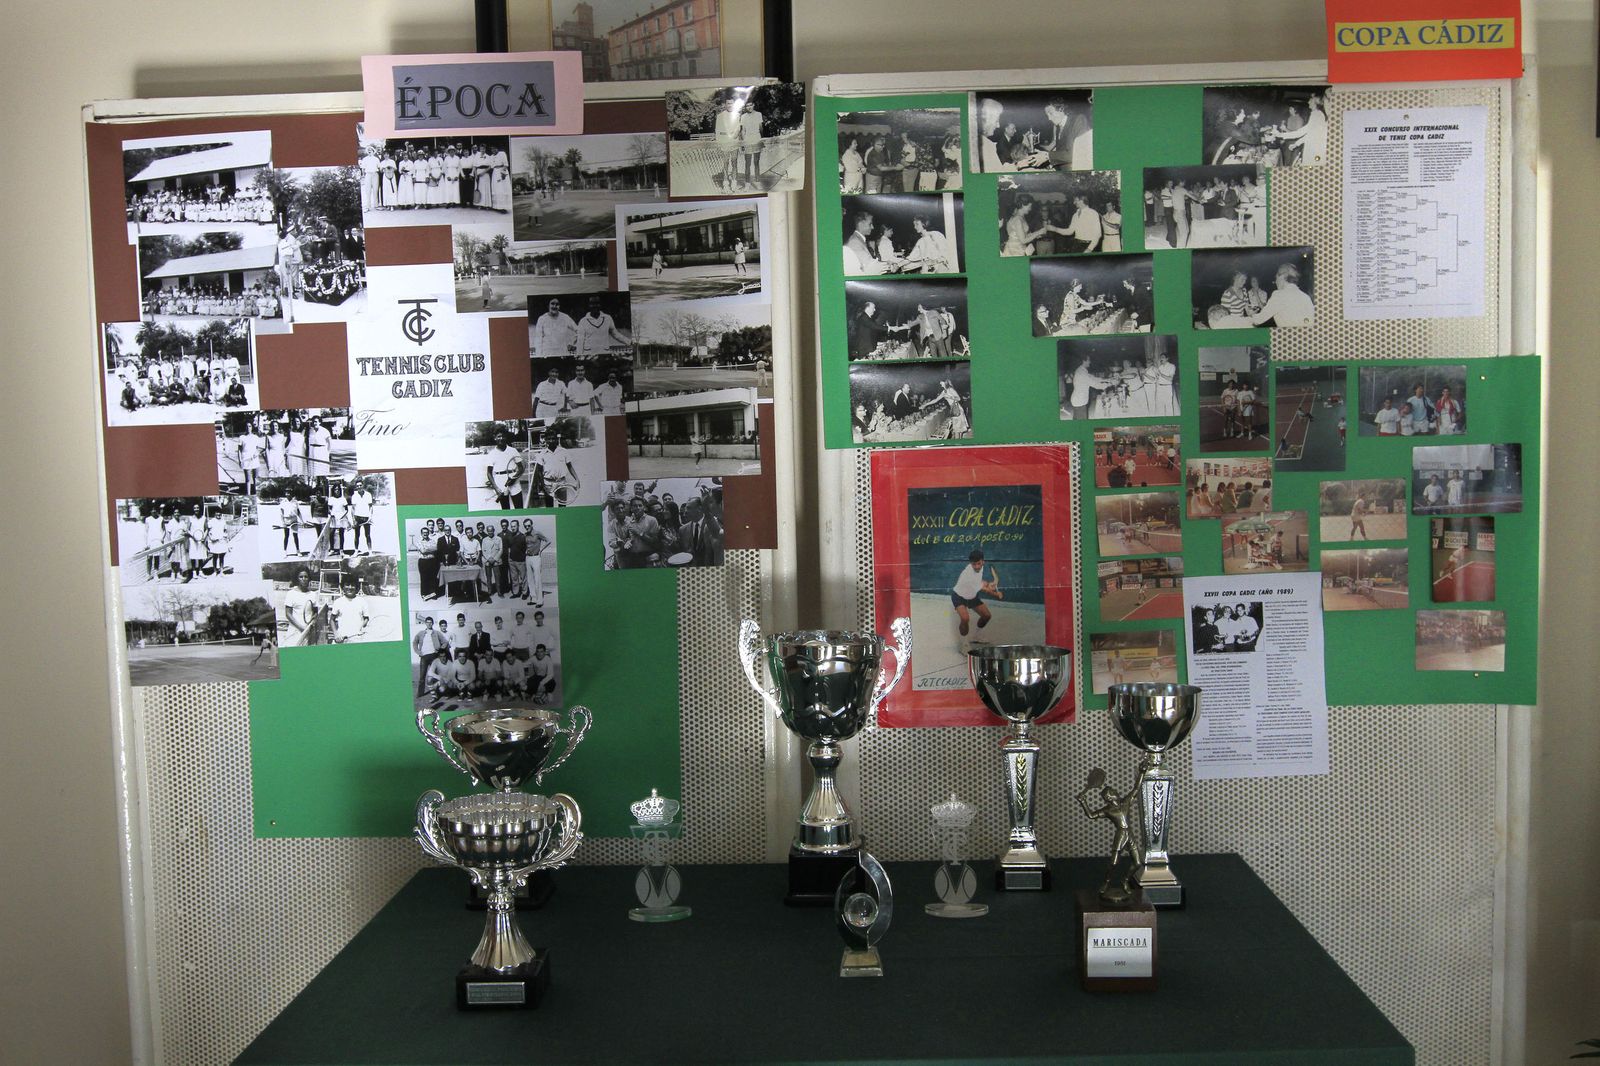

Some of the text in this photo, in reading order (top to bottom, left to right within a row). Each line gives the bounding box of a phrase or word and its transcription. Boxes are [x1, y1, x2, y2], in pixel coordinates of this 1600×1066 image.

[1337, 20, 1504, 47] COPA CÁDIZ
[395, 77, 549, 120] ÉPOCA
[356, 353, 485, 376] TENNIS CLUB
[391, 379, 453, 399] CADIZ
[355, 408, 410, 436] Fino
[948, 506, 984, 527] COPA
[987, 504, 1034, 526] CADIZ
[1093, 938, 1147, 947] MARISCADA
